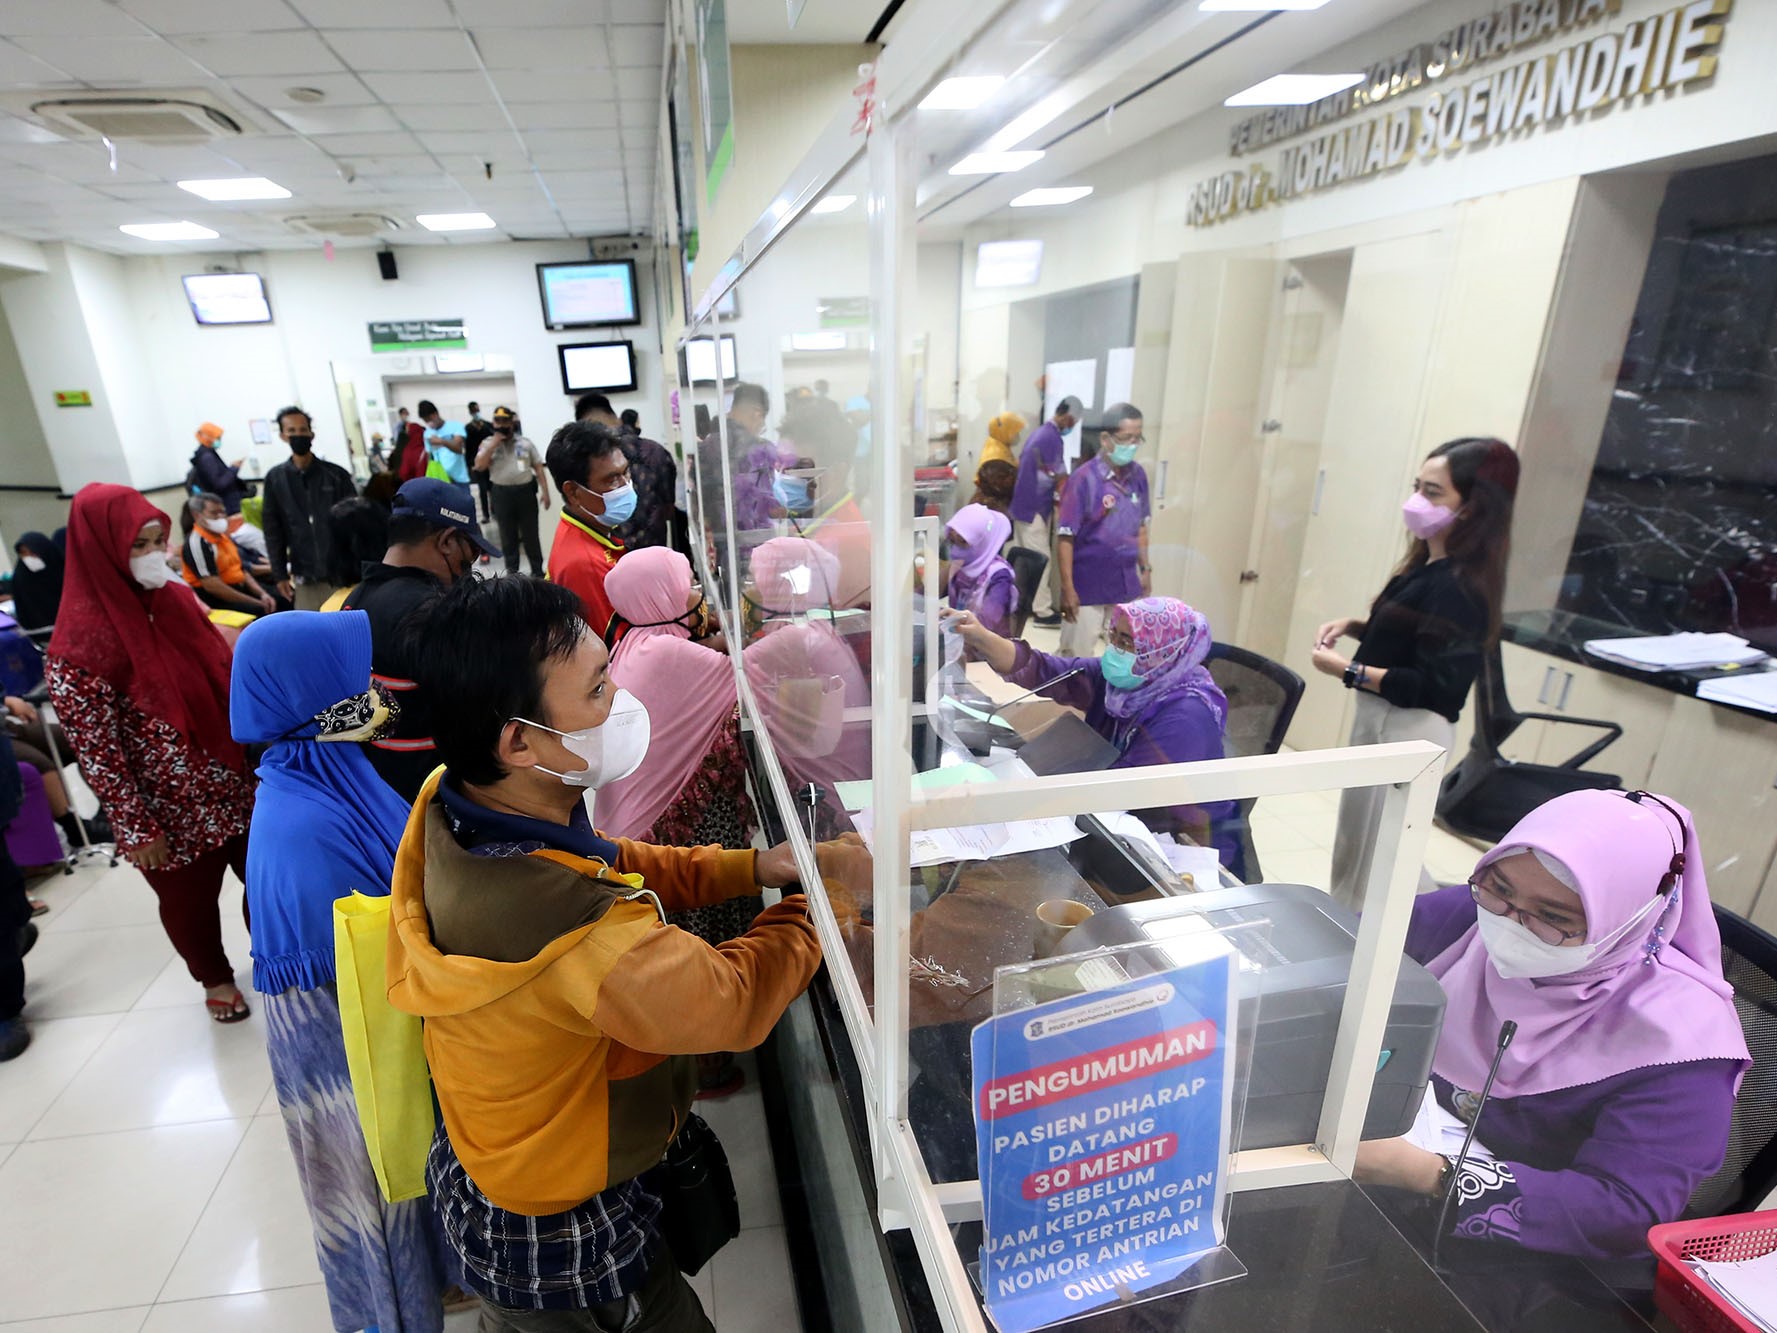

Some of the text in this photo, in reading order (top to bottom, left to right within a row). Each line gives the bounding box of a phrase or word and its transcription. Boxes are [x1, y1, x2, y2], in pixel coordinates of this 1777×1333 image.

[1186, 170, 1238, 226] RSUD
[1277, 107, 1413, 199] MOHAMAD
[1415, 0, 1730, 158] SOEWANDHIE
[988, 1030, 1206, 1110] PENGUMUMAN
[994, 1077, 1206, 1154] PASIEN DIHARAP
[1049, 1118, 1155, 1163] DATANG
[1034, 1138, 1168, 1194] 30 MENIT
[1047, 1167, 1155, 1212] SEBELUM
[986, 1172, 1213, 1253] JAM KEDATANGAN
[995, 1195, 1202, 1271] YANG TERTERA DI
[998, 1216, 1200, 1297] NOMOR ANTRIAN
[1062, 1260, 1151, 1301] ONLINE
